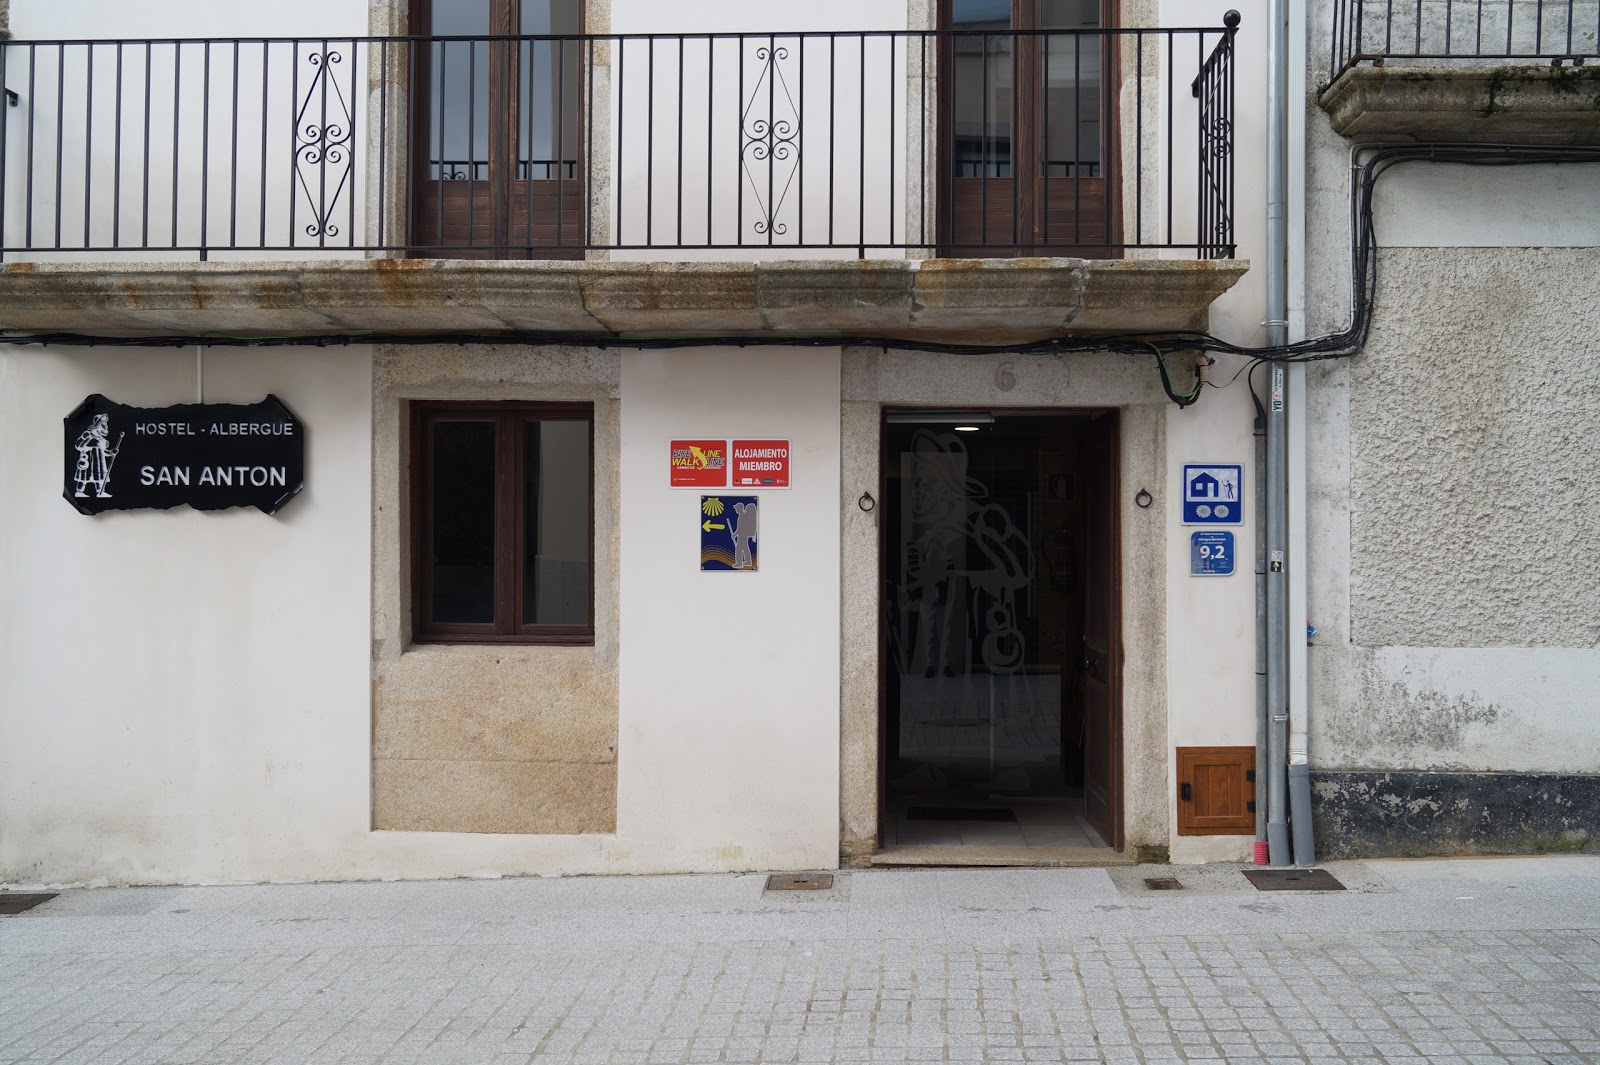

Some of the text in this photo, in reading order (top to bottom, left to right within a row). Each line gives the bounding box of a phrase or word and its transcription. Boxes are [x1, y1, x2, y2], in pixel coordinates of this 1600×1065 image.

[995, 361, 1016, 392] 6
[136, 422, 195, 436] HOSTEL
[209, 422, 293, 436] ALBERGUE
[673, 449, 722, 458] BIKE LINE
[734, 448, 787, 458] ALOJAMIENTO
[672, 458, 724, 466] WALK LINE
[739, 461, 782, 471] MIEMBRO
[140, 465, 286, 486] SAN ANTON
[1199, 545, 1225, 560] 9,2
